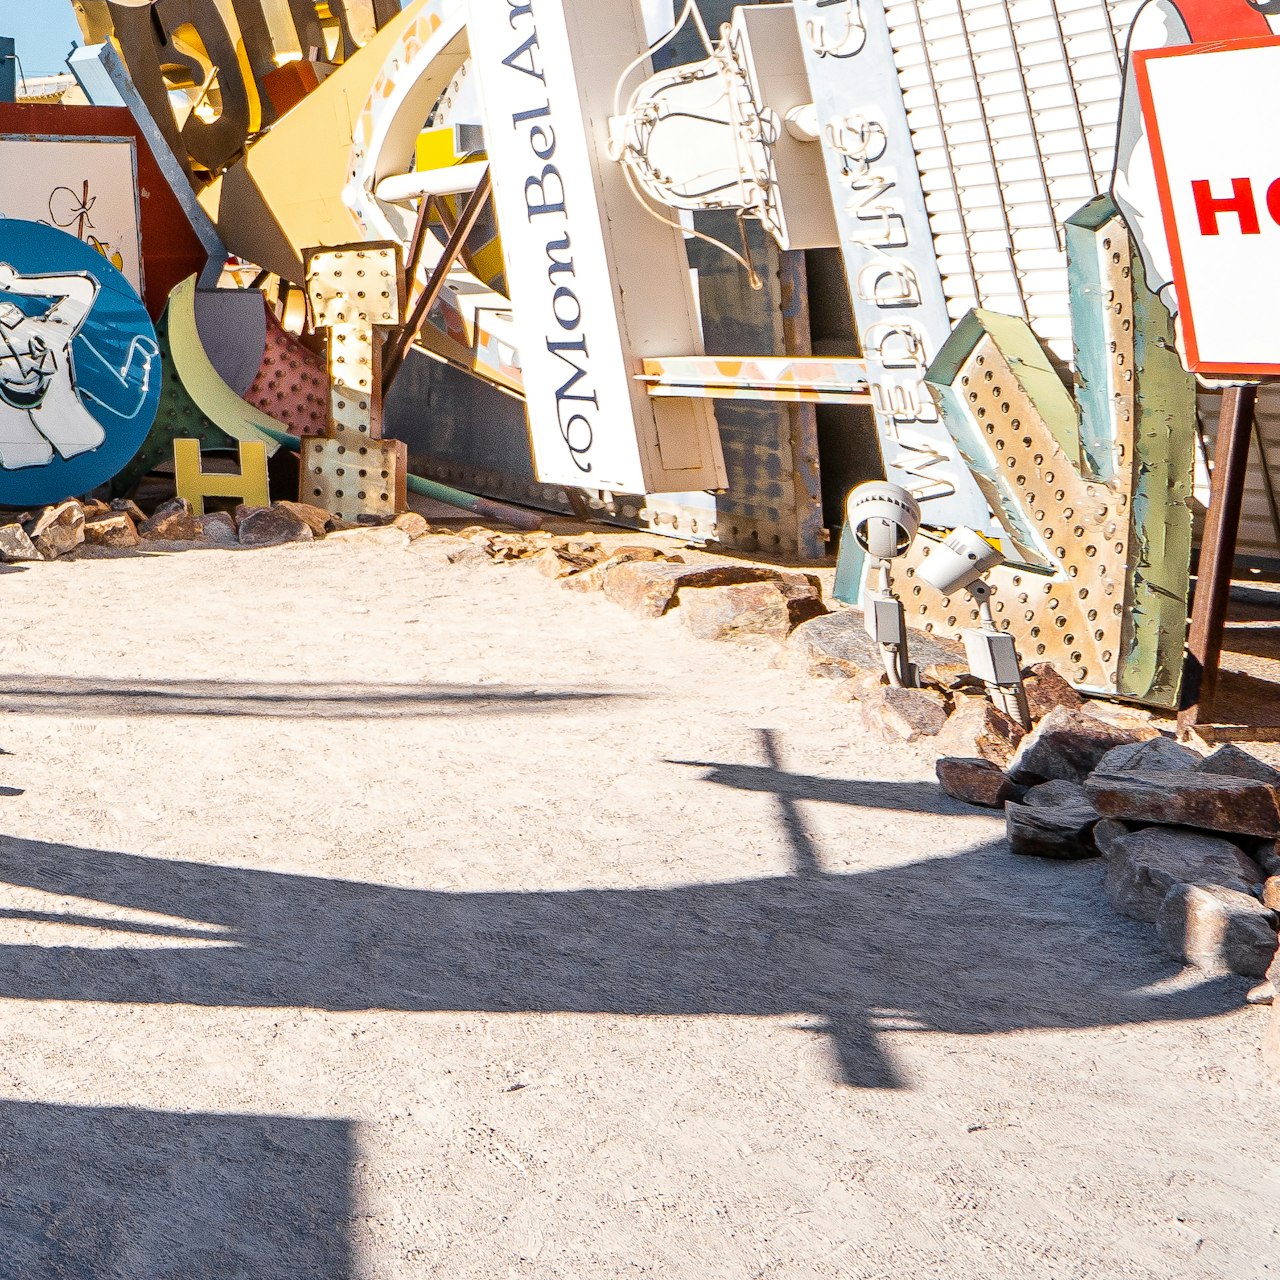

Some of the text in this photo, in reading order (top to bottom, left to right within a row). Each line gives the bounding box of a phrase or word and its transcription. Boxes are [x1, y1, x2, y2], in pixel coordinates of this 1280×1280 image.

[512, 98, 569, 225] Bel
[544, 230, 599, 474] Mon
[825, 112, 957, 503] WEDDING
[172, 437, 272, 517] H
